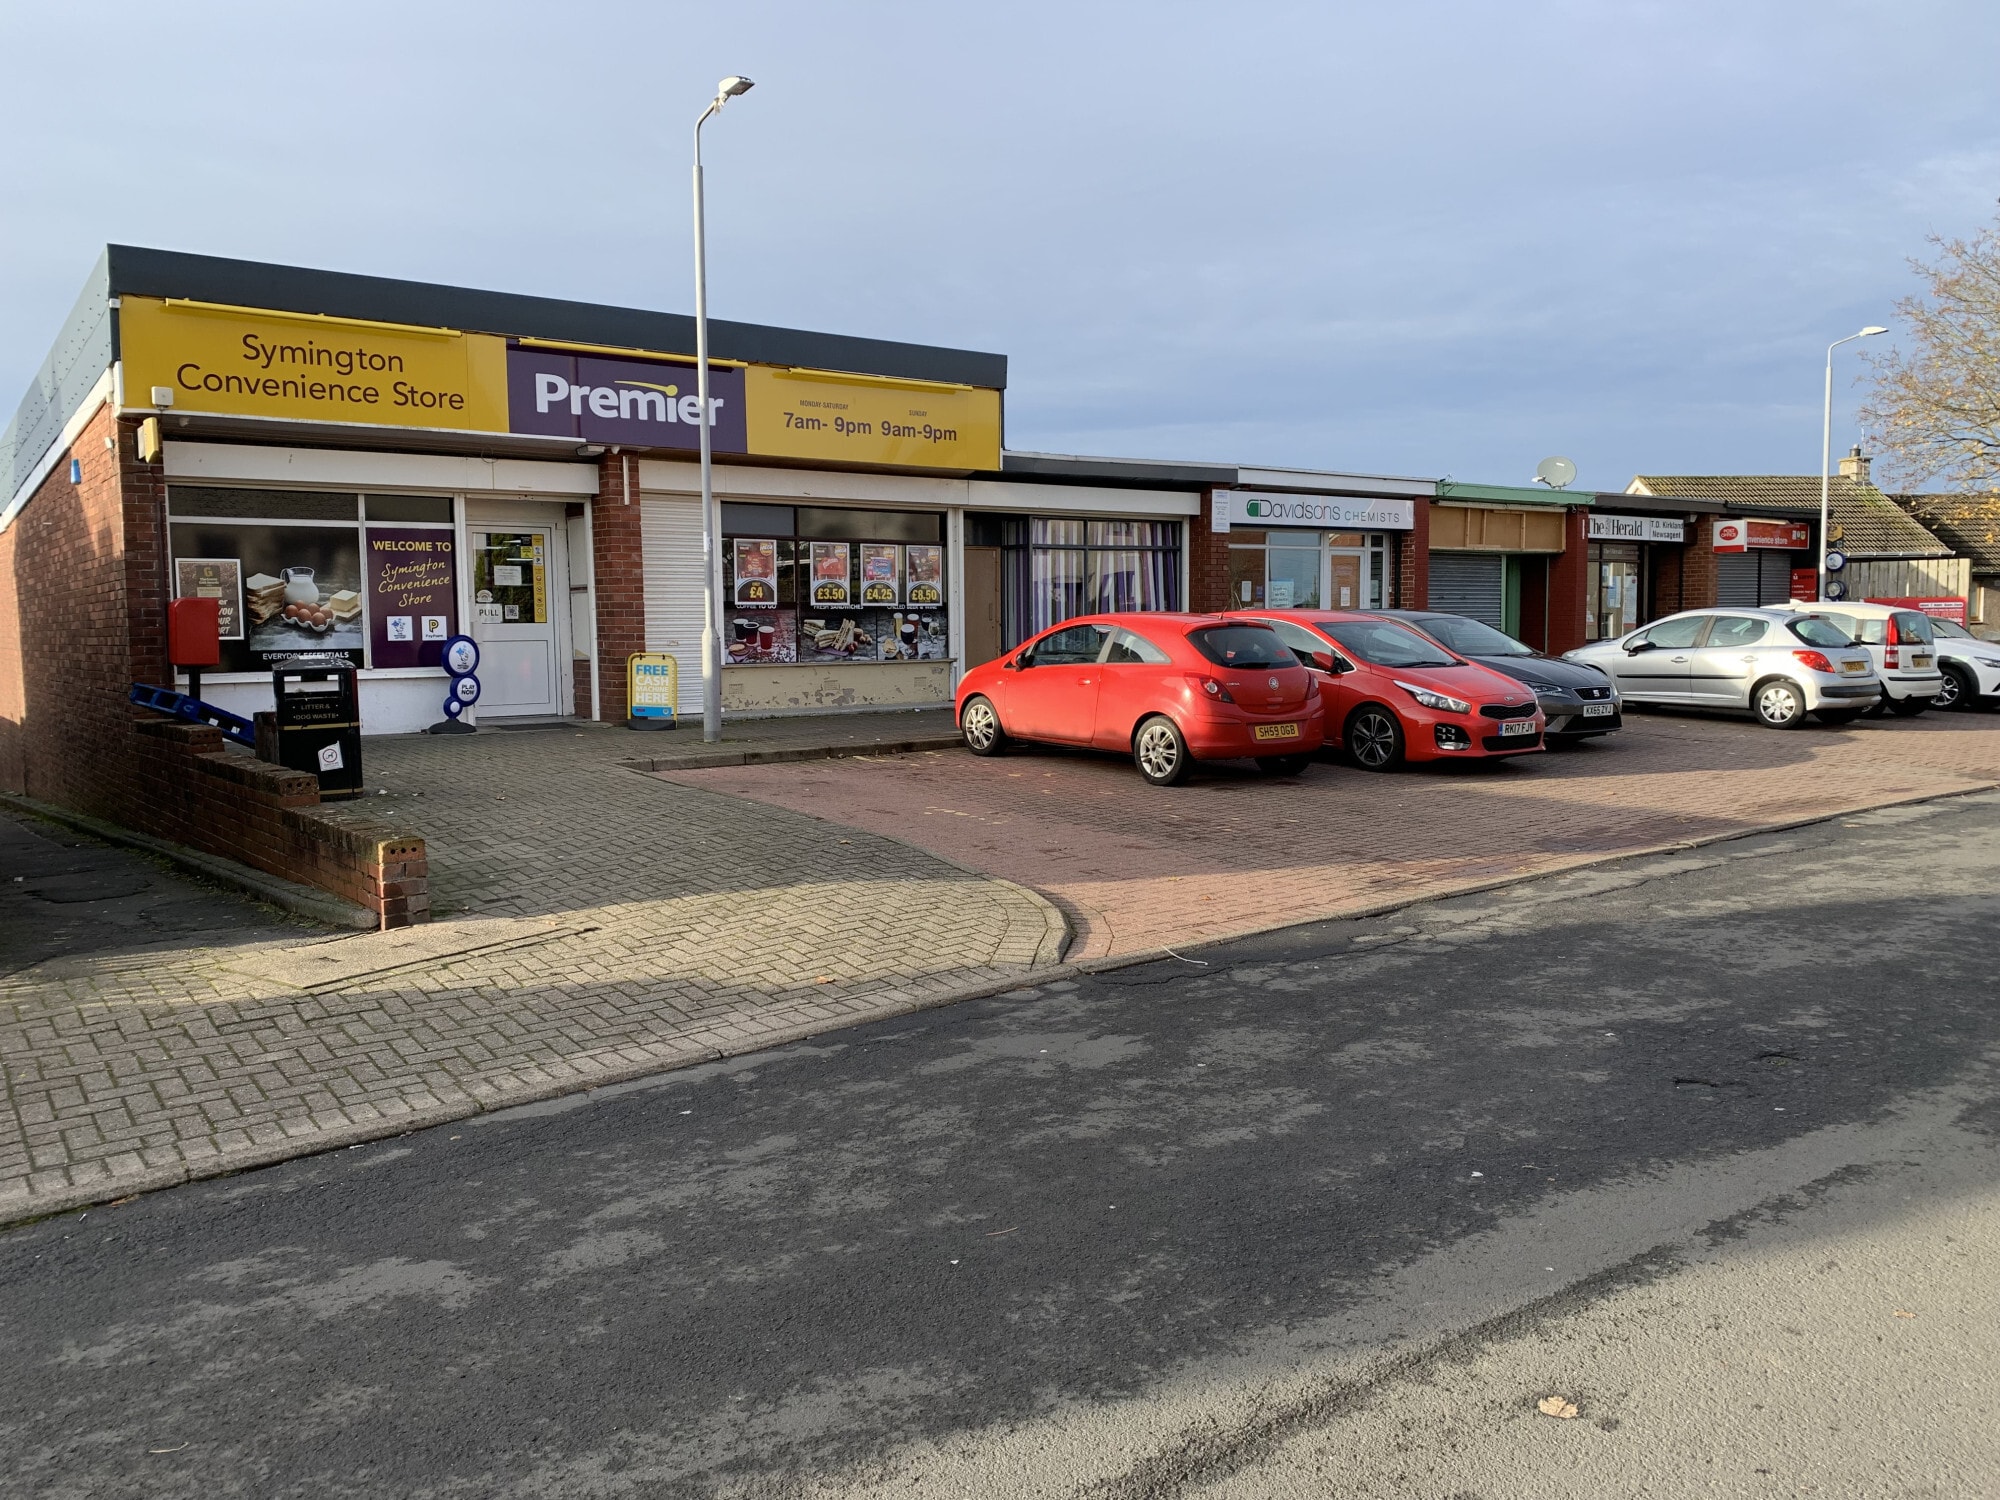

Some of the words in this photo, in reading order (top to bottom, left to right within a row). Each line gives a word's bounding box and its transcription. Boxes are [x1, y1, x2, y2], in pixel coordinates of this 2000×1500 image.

[242, 334, 404, 376] Symington
[176, 363, 380, 404] Convenience
[392, 381, 465, 410] Store
[535, 373, 724, 426] Premier
[908, 409, 928, 417] SUNDAY
[834, 416, 872, 437] 9pm
[881, 420, 957, 443] 9am-9pm
[1259, 499, 1341, 521] Davidsons
[1344, 510, 1400, 523] CHEMISTS
[1588, 517, 1604, 535] The
[1611, 519, 1643, 537] Herald
[1662, 521, 1684, 530] Kirkland
[1652, 530, 1681, 540] Newsagent
[1774, 536, 1788, 545] store
[372, 540, 433, 552] WELCOME
[435, 541, 452, 552] TO
[381, 557, 446, 583] Symington
[378, 575, 450, 593] Convenience
[750, 586, 763, 599] £4
[817, 588, 845, 600] £3.50
[866, 588, 893, 600] £4.25
[911, 589, 937, 601] £8.50
[398, 592, 432, 607] Store
[479, 609, 499, 617] PULL
[262, 652, 300, 660] EVERYDAY
[635, 664, 669, 676] FREE
[635, 676, 669, 686] CASH
[635, 692, 669, 704] HERE
[312, 712, 336, 720] WASTE
[1258, 725, 1279, 738] SH59
[1280, 724, 1296, 736] OGB
[1504, 723, 1521, 734] RK17
[1521, 722, 1534, 733] FJY
